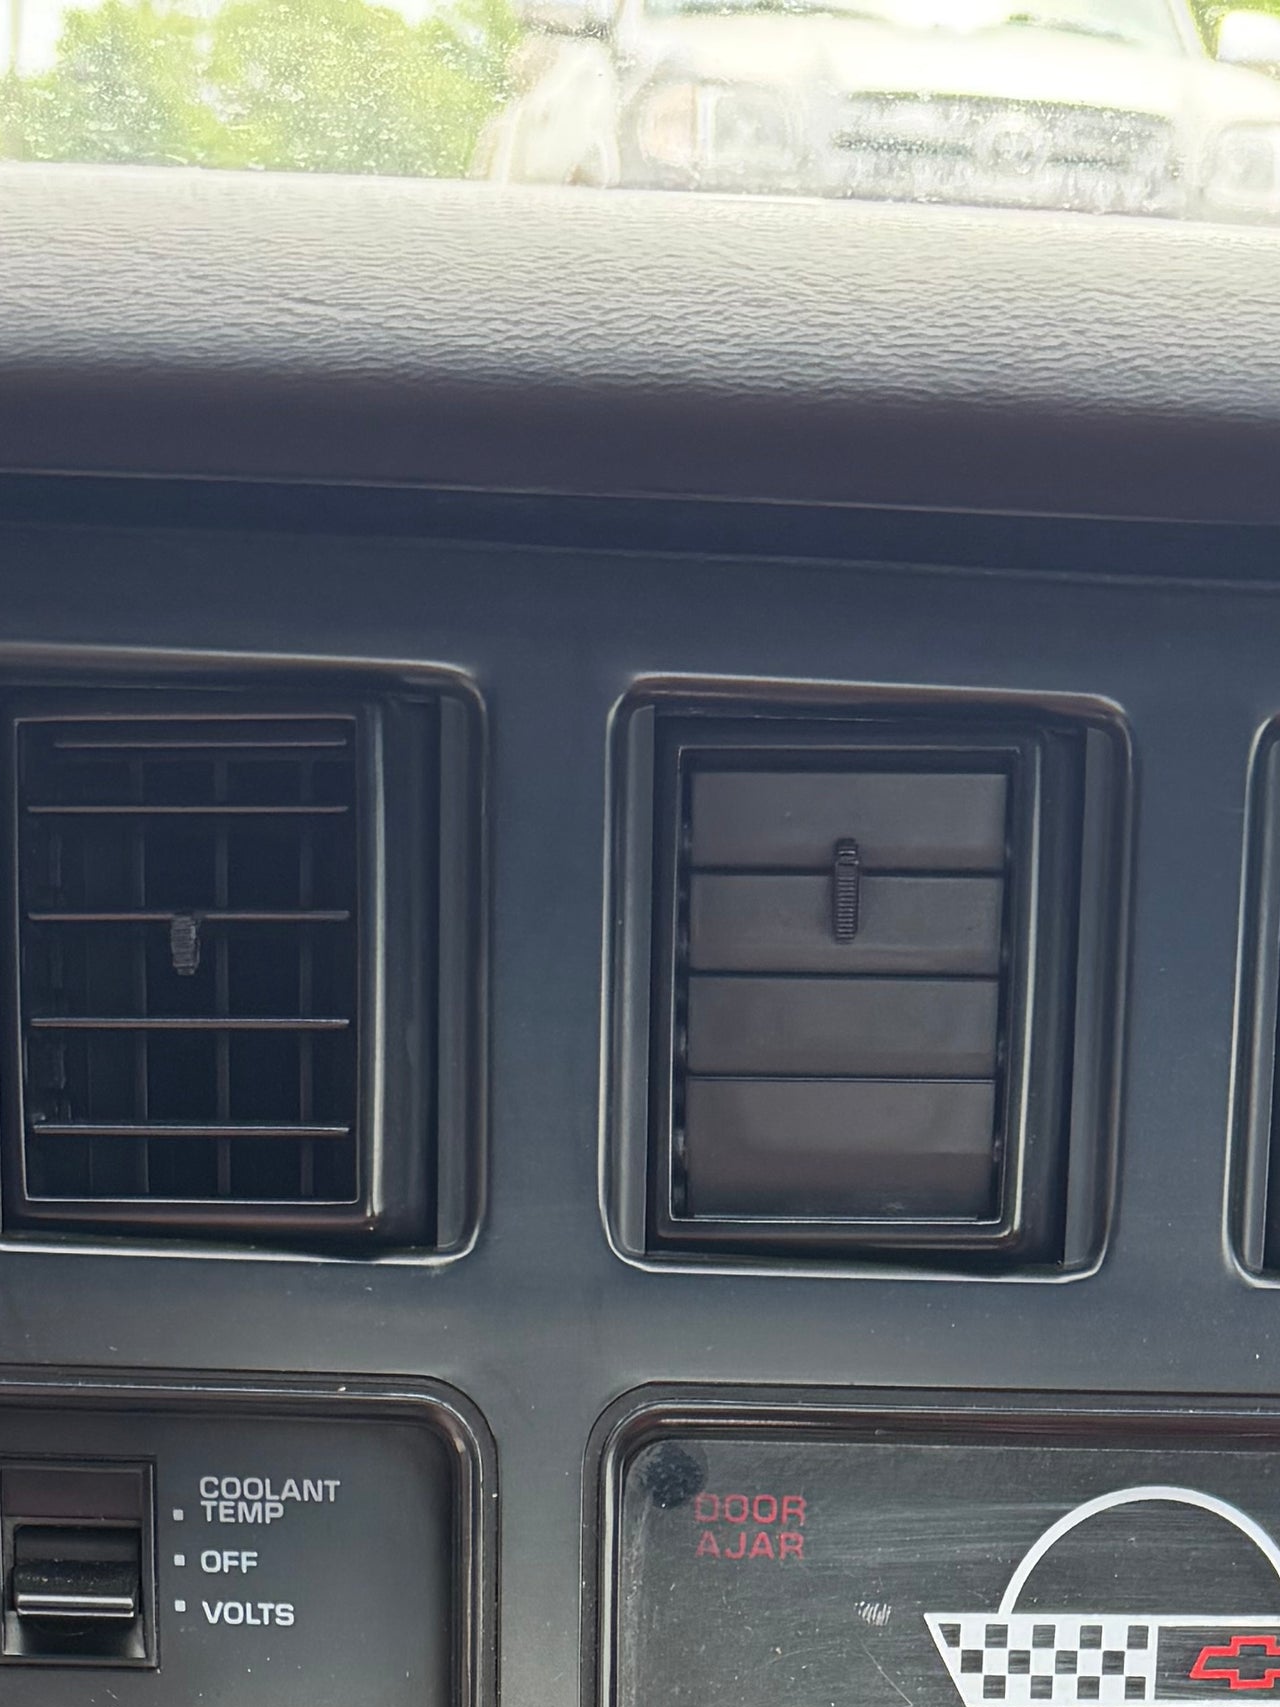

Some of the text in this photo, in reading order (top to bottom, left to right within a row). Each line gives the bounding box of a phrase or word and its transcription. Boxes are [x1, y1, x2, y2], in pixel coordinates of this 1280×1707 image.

[200, 1478, 340, 1502] COOLANT
[201, 1502, 284, 1524] TEMP
[693, 1493, 808, 1525] DOOR
[695, 1531, 806, 1560] AJAR
[201, 1551, 258, 1574] OFF
[203, 1602, 295, 1626] VOLTS
